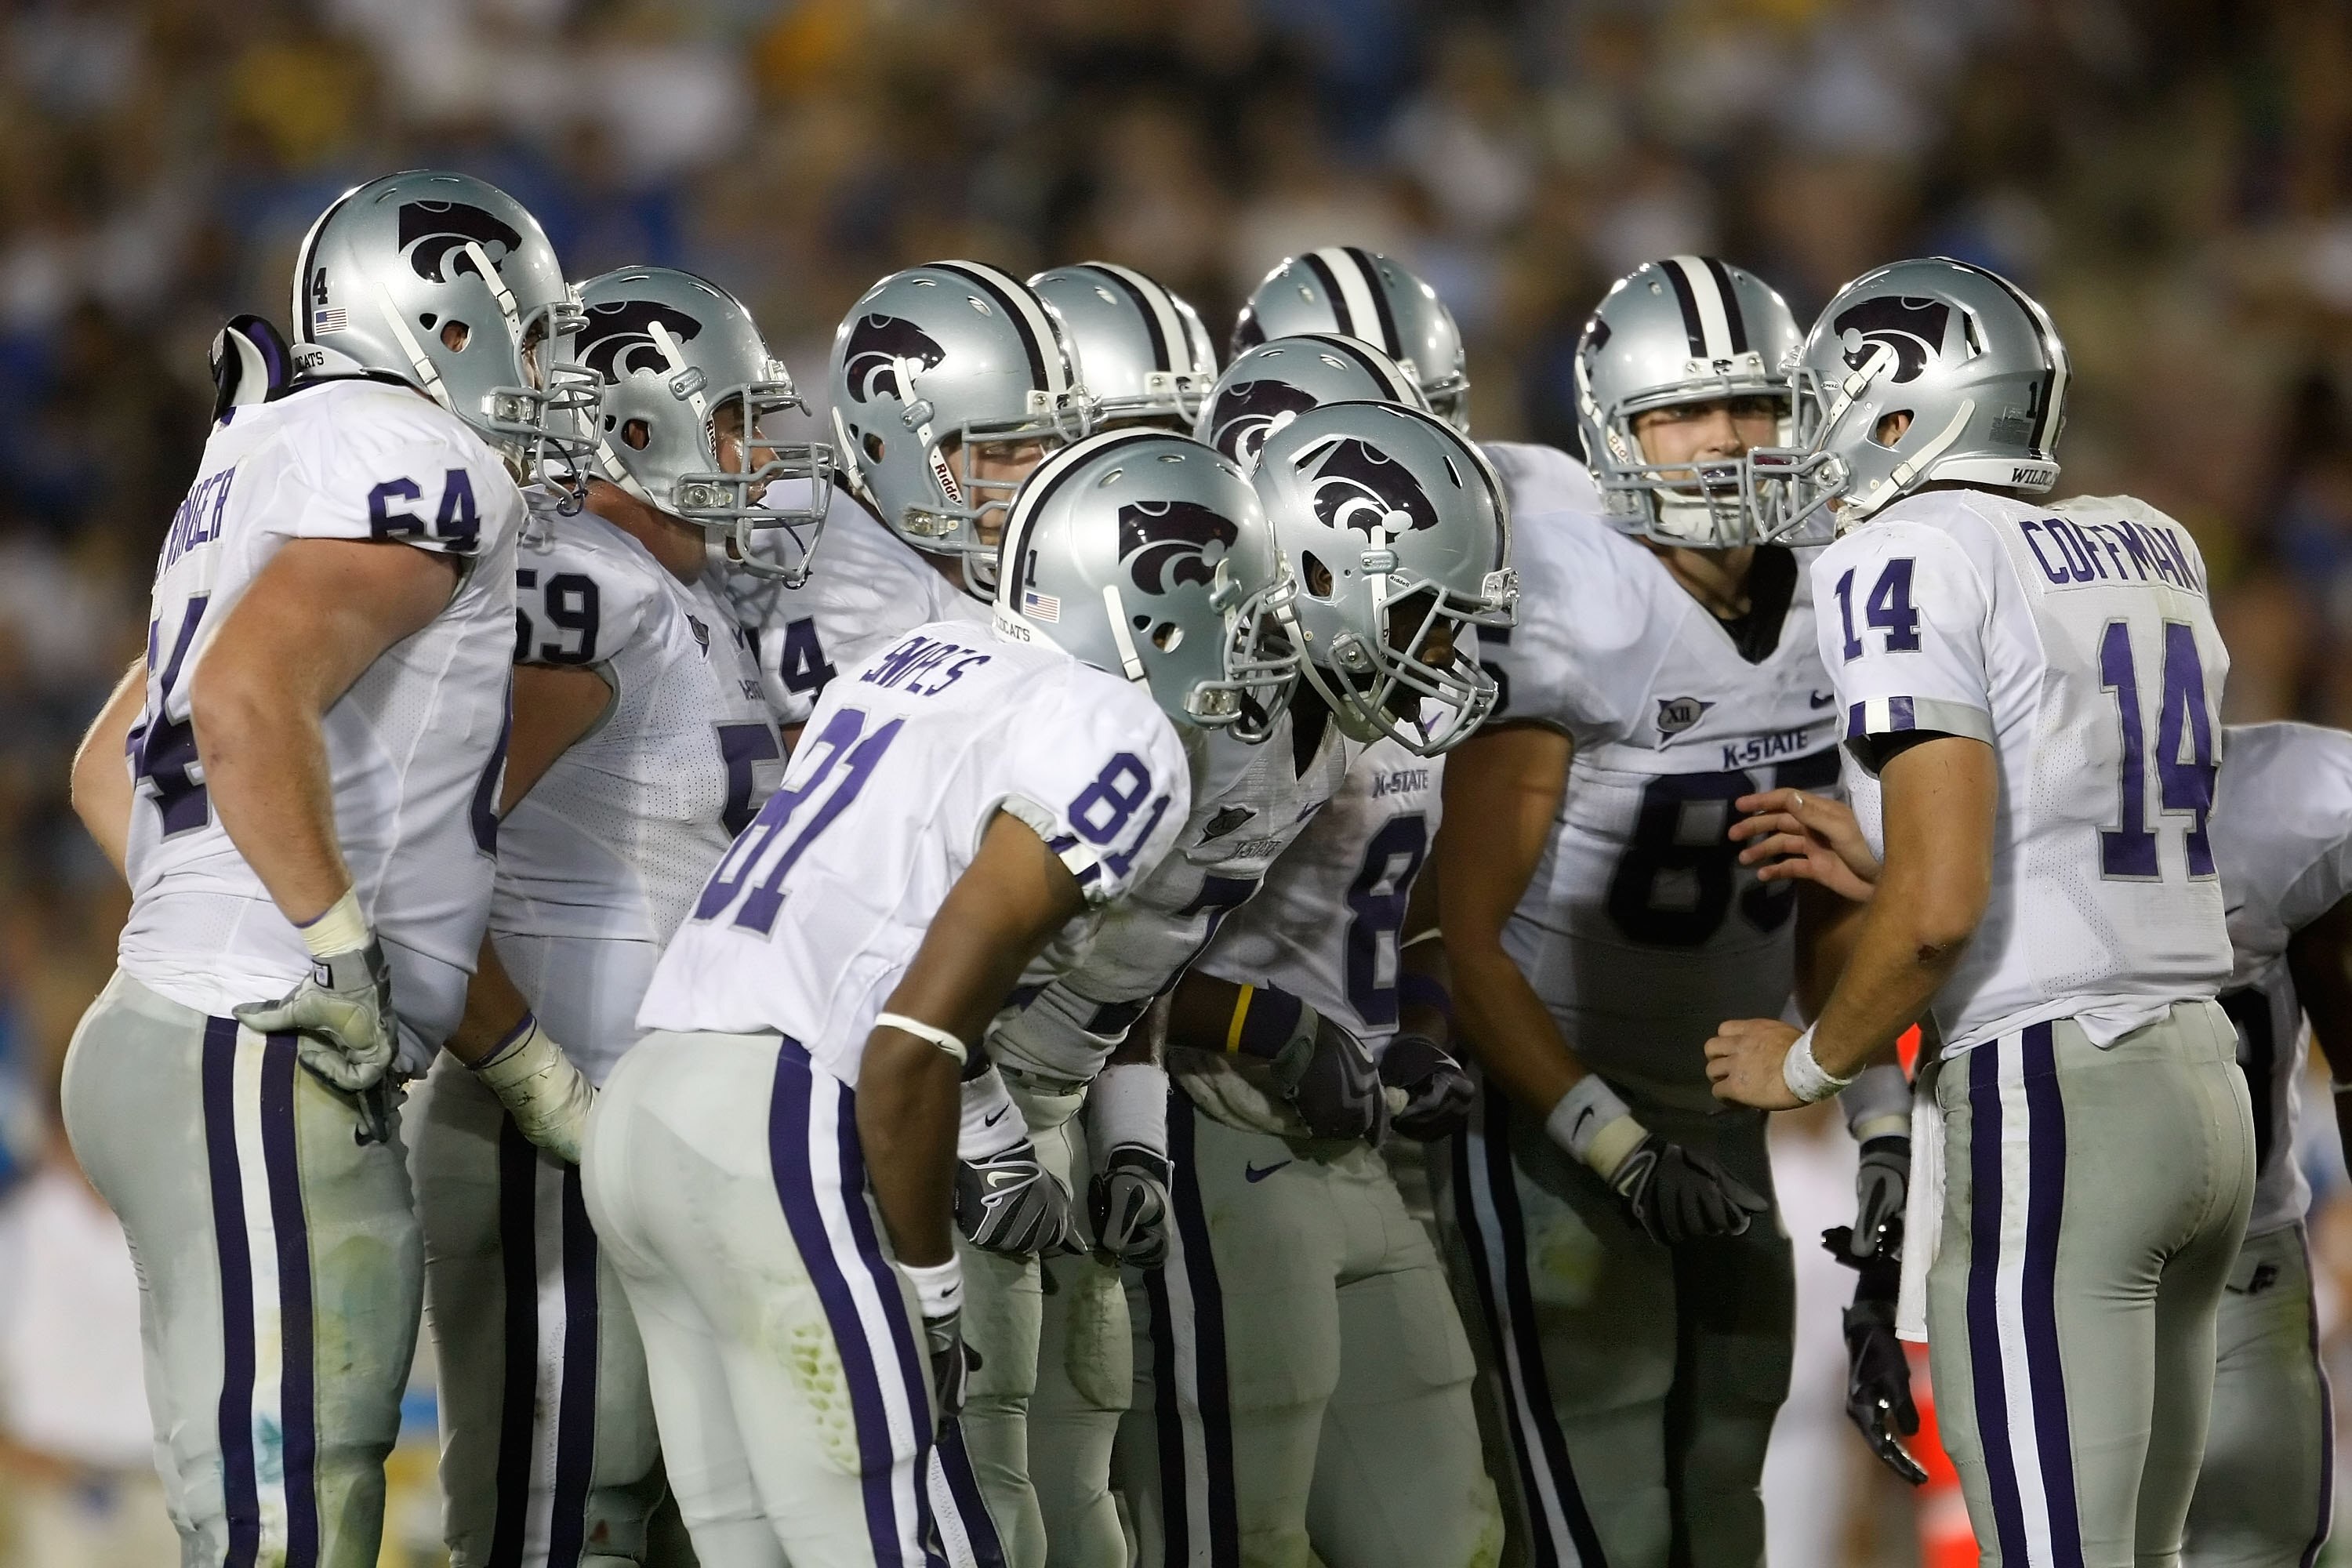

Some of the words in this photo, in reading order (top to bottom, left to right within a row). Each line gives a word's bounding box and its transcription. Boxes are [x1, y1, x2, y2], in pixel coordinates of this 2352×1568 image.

[313, 267, 328, 306] 4
[2026, 381, 2038, 419] 1
[367, 468, 481, 553] 64
[1388, 575, 1410, 589] Riddell
[2018, 517, 2204, 594] COFFMAN
[1833, 556, 1923, 666] 14
[858, 636, 992, 697] SNIPES
[1666, 706, 1693, 724] XII
[1723, 728, 1809, 771] K-STATE
[2095, 615, 2223, 883] 14
[1372, 769, 1428, 798] K-STATE
[688, 704, 911, 942] 81
[1069, 752, 1172, 880] 81
